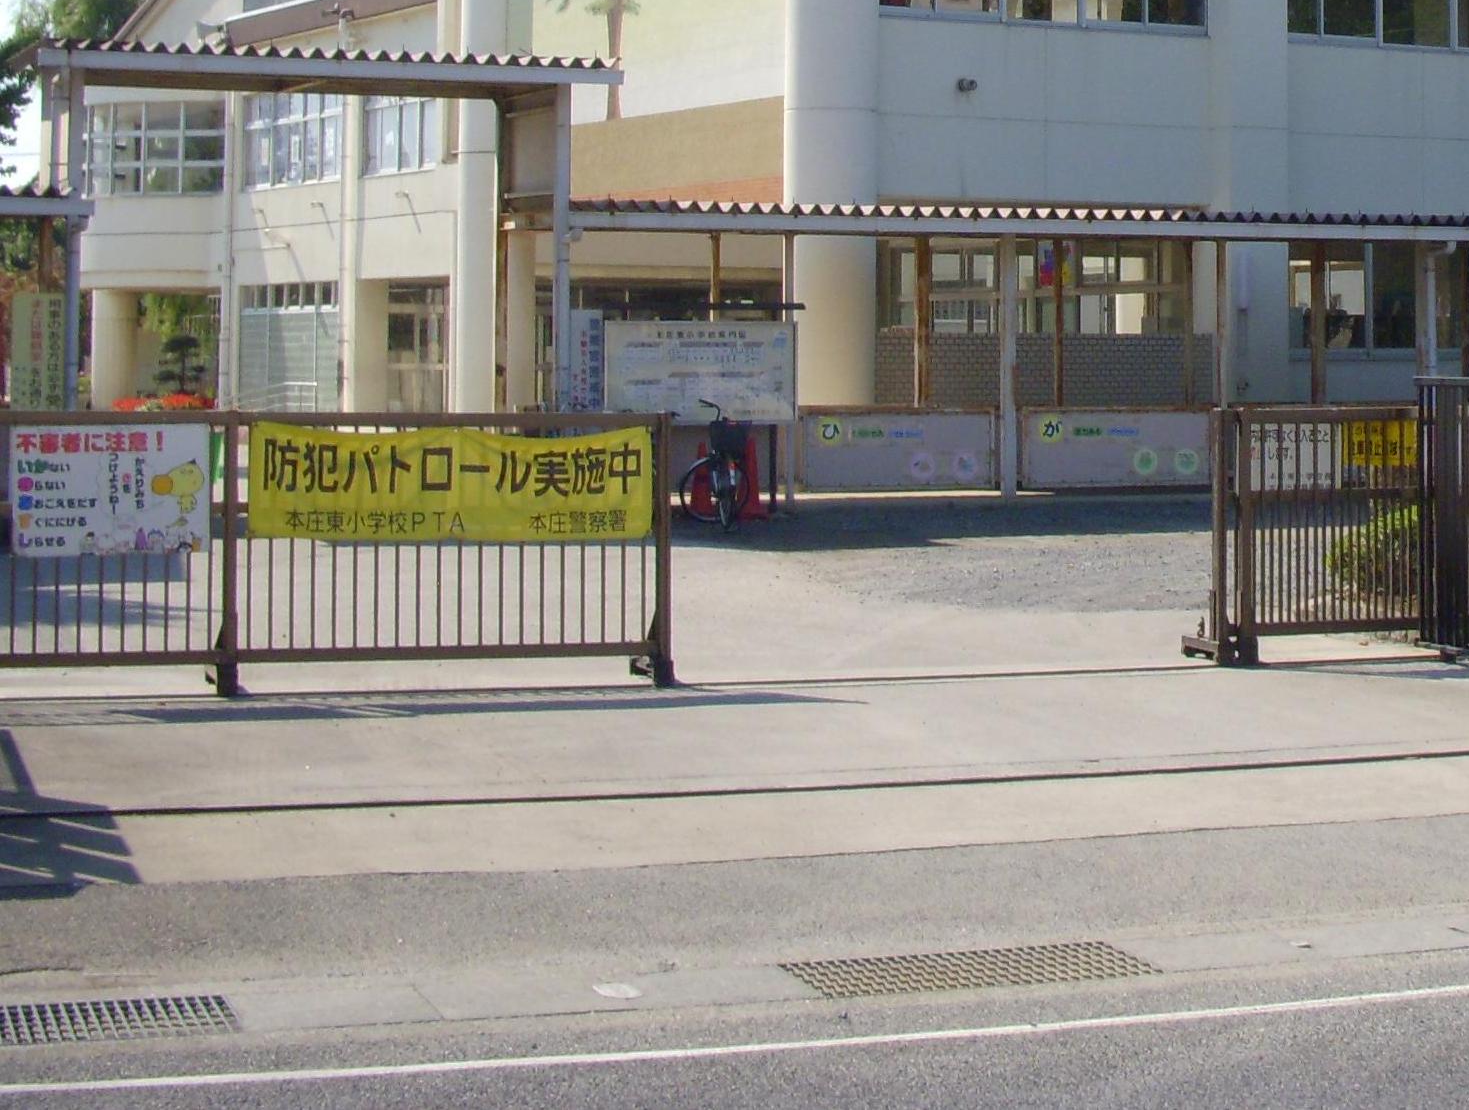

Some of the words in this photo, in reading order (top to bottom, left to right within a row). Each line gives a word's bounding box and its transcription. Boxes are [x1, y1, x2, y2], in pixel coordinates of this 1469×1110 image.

[821, 423, 841, 440] ひ
[1042, 421, 1063, 438] が
[17, 459, 71, 474] いかない
[262, 438, 642, 498] 防犯パトロール実施中
[528, 509, 628, 535] 本庄警察署
[18, 533, 66, 548] しらせる
